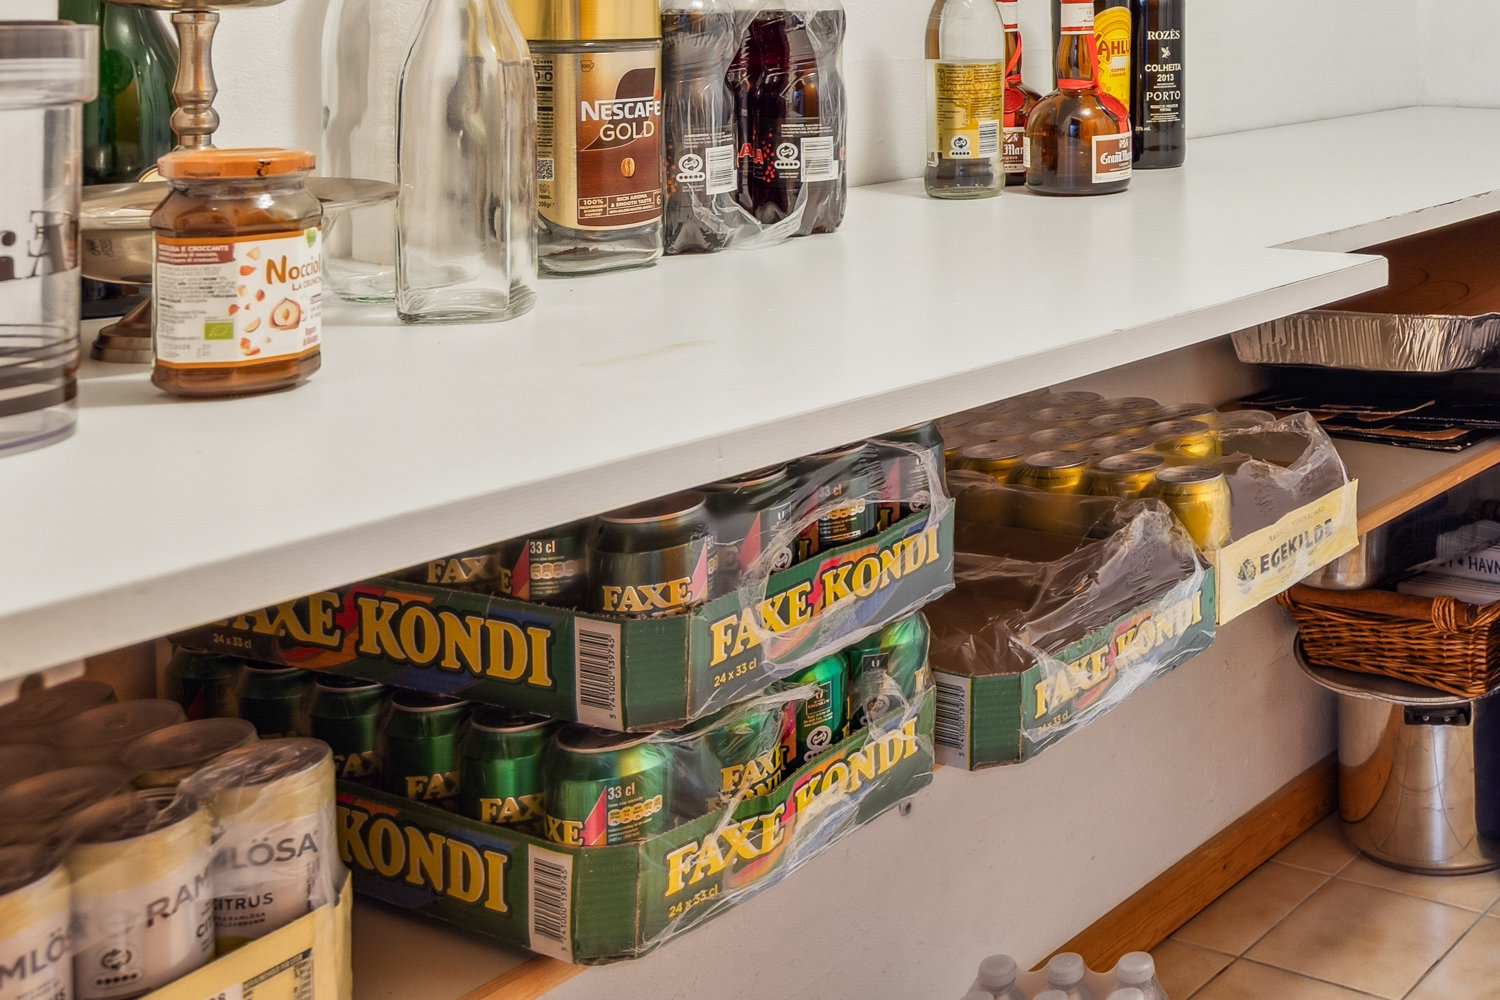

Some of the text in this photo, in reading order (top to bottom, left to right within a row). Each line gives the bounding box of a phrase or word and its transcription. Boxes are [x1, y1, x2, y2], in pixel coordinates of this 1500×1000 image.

[1147, 30, 1180, 41] ROZÈS
[1144, 63, 1182, 72] COLHEITA
[1157, 74, 1174, 82] 2013
[1146, 90, 1181, 101] PORTO
[600, 120, 655, 142] GOLD
[583, 198, 604, 206] 100%
[616, 199, 638, 207] SMOOTH
[833, 483, 842, 496] cl
[529, 540, 556, 554] 33 cl
[1260, 517, 1333, 574] EGEKILDE
[427, 555, 490, 584] FAX
[602, 575, 692, 612] FAXE
[709, 524, 940, 667] FAXE KONDI
[213, 633, 224, 644] 24
[232, 635, 244, 647] 33
[357, 597, 553, 687] KONDI
[607, 638, 616, 670] 139745
[1033, 590, 1202, 720] FAXE KONDI
[713, 673, 727, 688] 24
[735, 664, 748, 679] 33
[748, 657, 757, 670] cl
[608, 674, 616, 708] 741000
[405, 770, 460, 800] FAX
[607, 782, 635, 800] 33 cl
[480, 792, 546, 824] FAX
[664, 803, 787, 897] FAXE
[795, 716, 919, 818] KONDI
[337, 806, 508, 913] KONDI
[668, 902, 683, 918] 24
